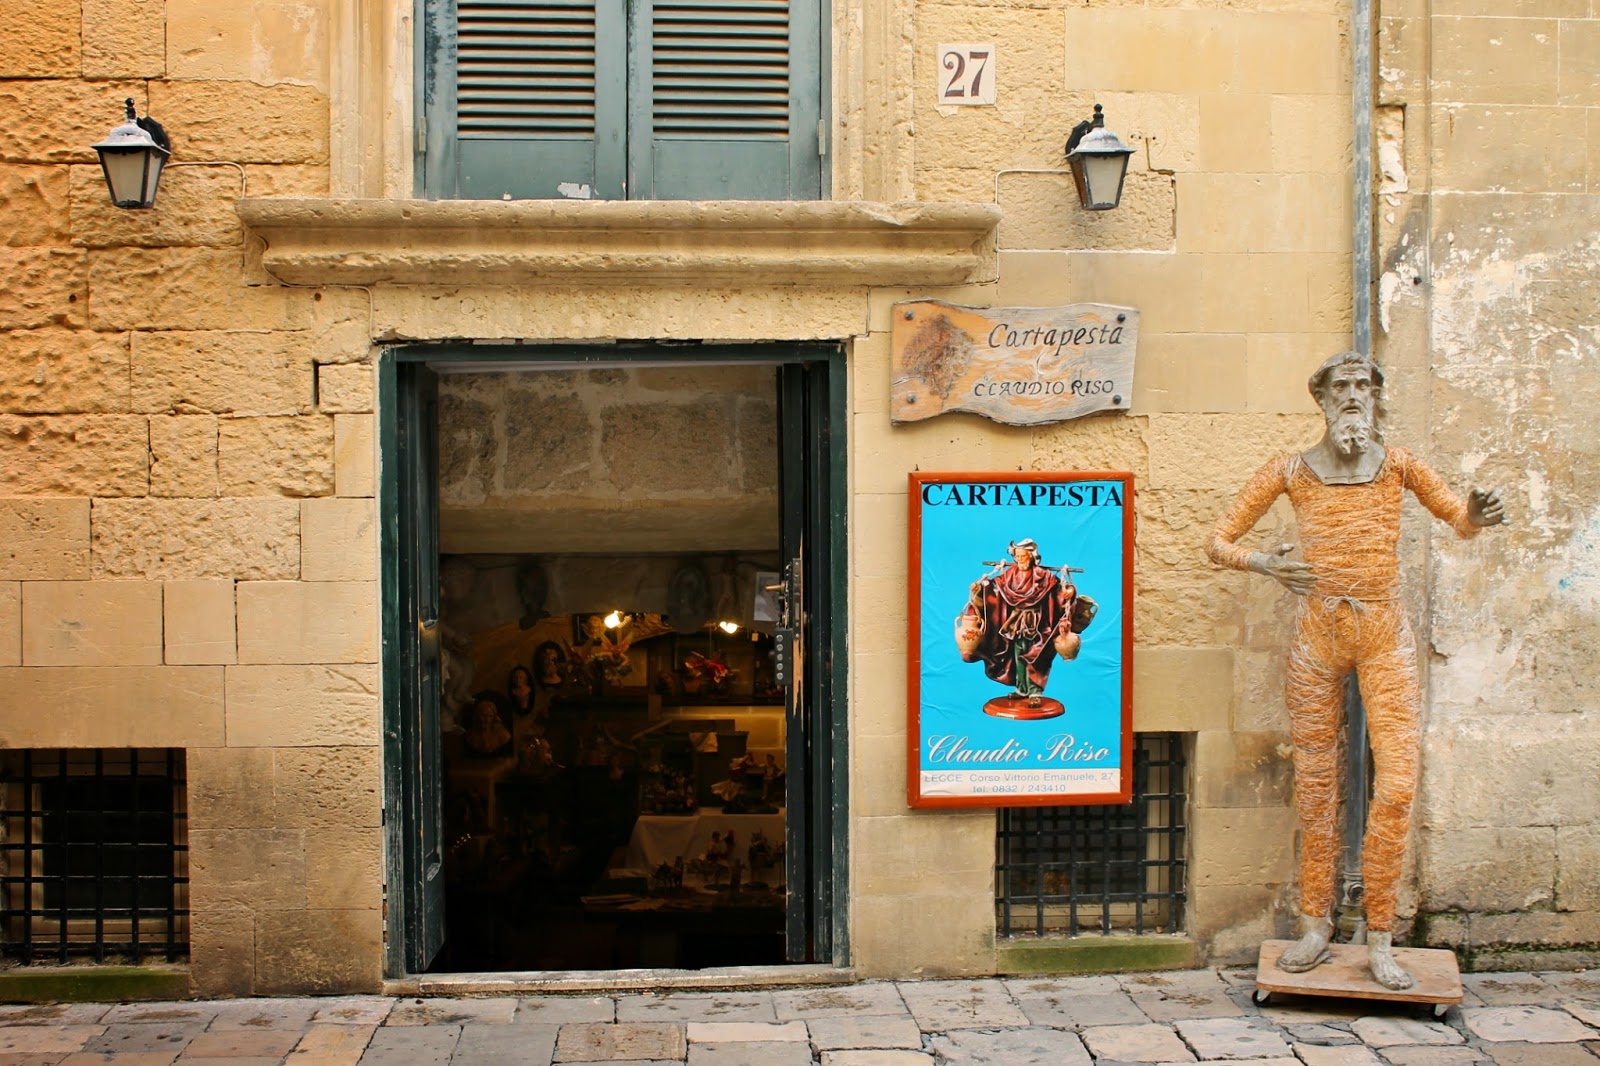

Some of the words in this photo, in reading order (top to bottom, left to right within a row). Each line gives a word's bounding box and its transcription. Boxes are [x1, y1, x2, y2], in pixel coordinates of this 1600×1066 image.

[943, 51, 989, 98] 27
[988, 323, 1123, 356] Cartapesta
[974, 380, 1065, 397] CLAUDIO
[1070, 379, 1114, 397] RISO
[922, 484, 1123, 507] CARTAPESTA
[927, 734, 1030, 763] Claudio
[1037, 733, 1110, 762] Riso
[924, 774, 963, 783] LECCE
[969, 773, 1001, 783] Corso
[1003, 773, 1040, 782] Vittorio
[1043, 772, 1098, 782] Emanuele,
[1101, 772, 1114, 781] 27
[973, 785, 988, 793] tel.
[992, 785, 1018, 793] 0832
[1028, 784, 1066, 793] 243410
